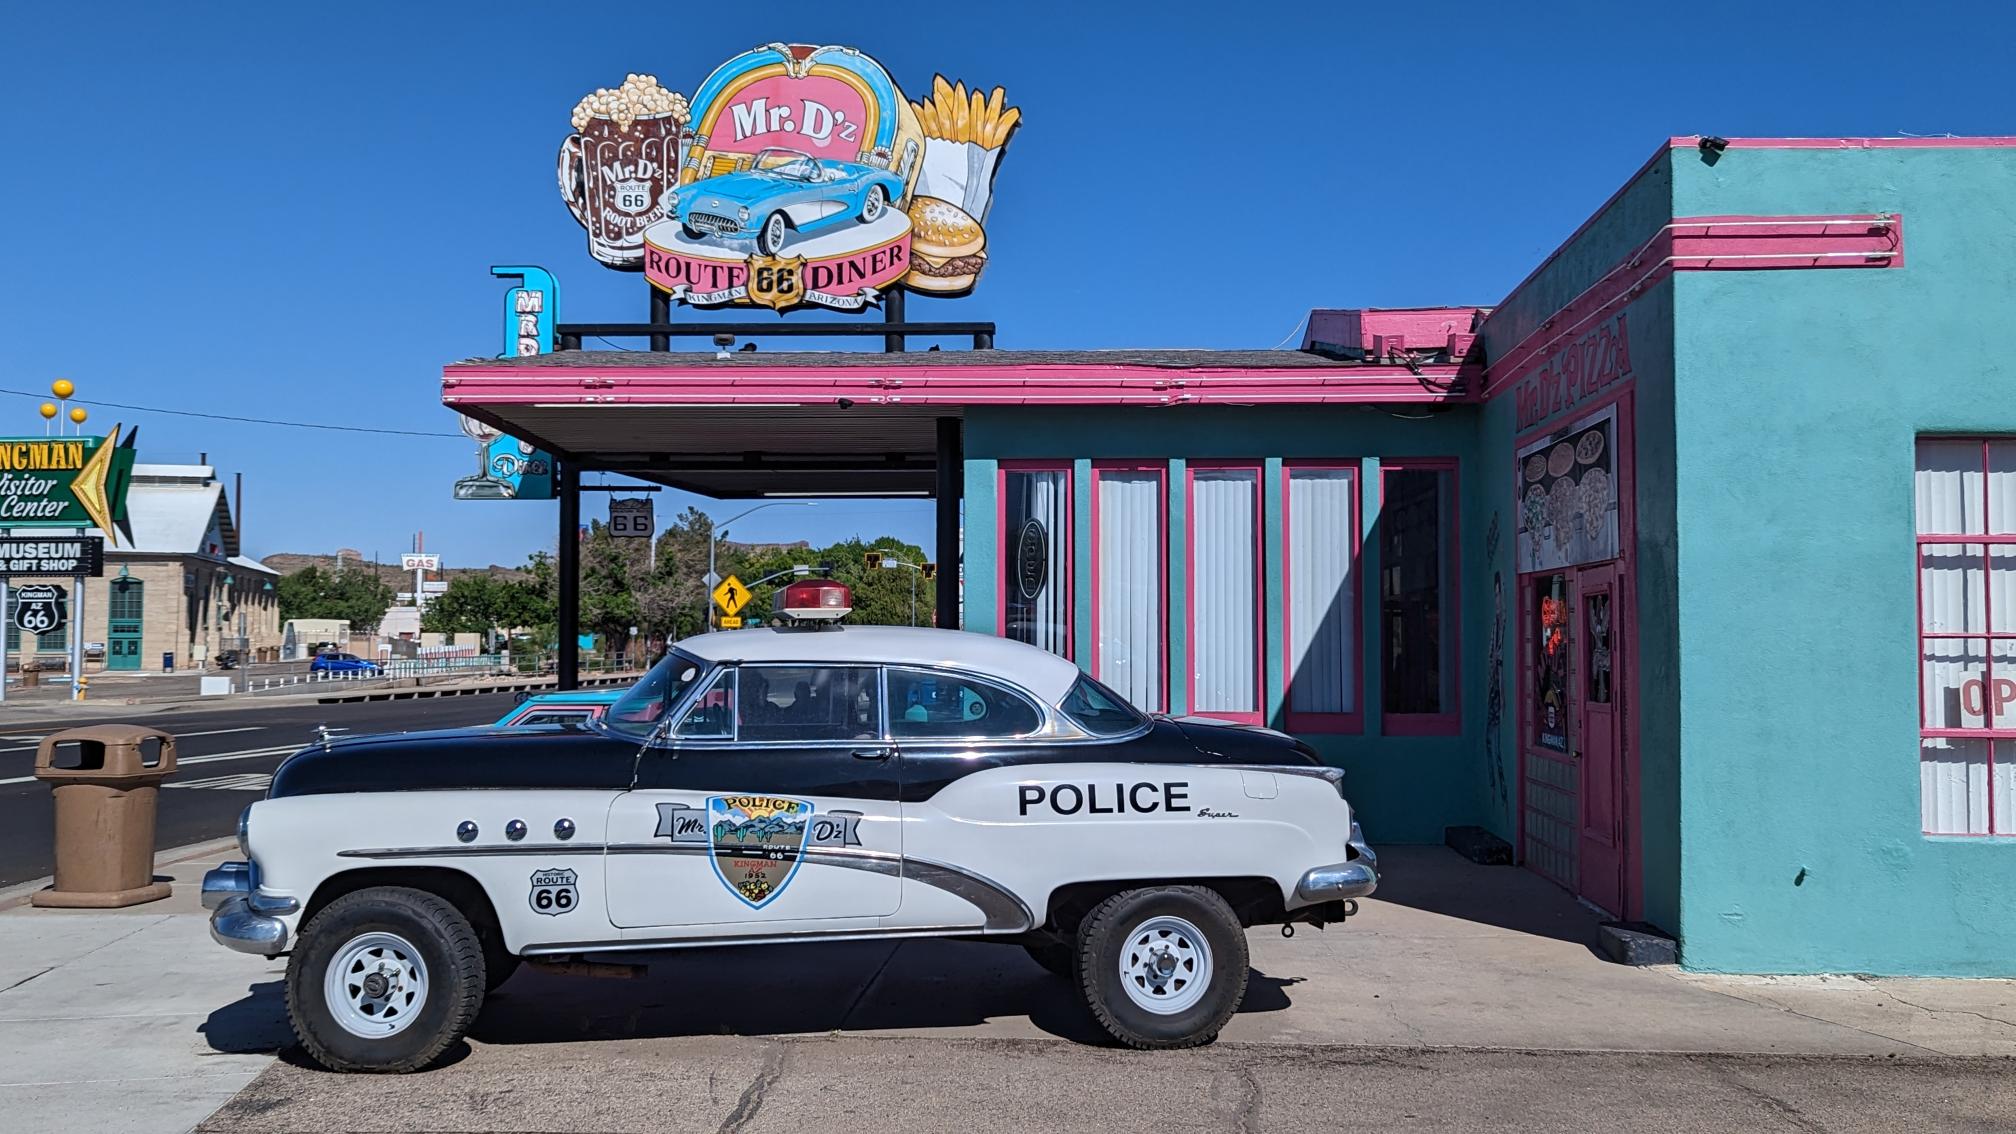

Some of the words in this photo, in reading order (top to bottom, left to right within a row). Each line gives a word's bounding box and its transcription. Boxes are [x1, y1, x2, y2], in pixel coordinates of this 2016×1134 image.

[729, 97, 796, 142] Mr.
[799, 99, 858, 142] D'z
[601, 160, 635, 185] Mr.
[637, 159, 663, 179] D'z
[622, 194, 645, 207] 66
[603, 207, 633, 227] ROOT
[636, 205, 665, 226] BEER
[649, 248, 746, 289] ROUTE
[756, 267, 794, 294] 66
[811, 244, 903, 290] DINER
[688, 287, 745, 302] KINGMAN
[808, 292, 860, 307] ARIZONA
[1561, 313, 1633, 409] PIZZA
[1, 495, 69, 517] Center
[613, 515, 649, 531] 66
[9, 560, 38, 571] GIFT
[40, 560, 77, 571] SHOP
[406, 559, 434, 568] GAS
[30, 602, 44, 610] AZ
[24, 611, 49, 628] 66
[724, 797, 799, 814] POLICE
[1018, 782, 1191, 816] POLICE
[1197, 807, 1239, 819] Super
[676, 816, 707, 835] Mr.
[813, 820, 843, 841] D'z
[733, 860, 777, 868] KINGMAN
[536, 876, 572, 884] ROUTE
[536, 888, 572, 909] 66
